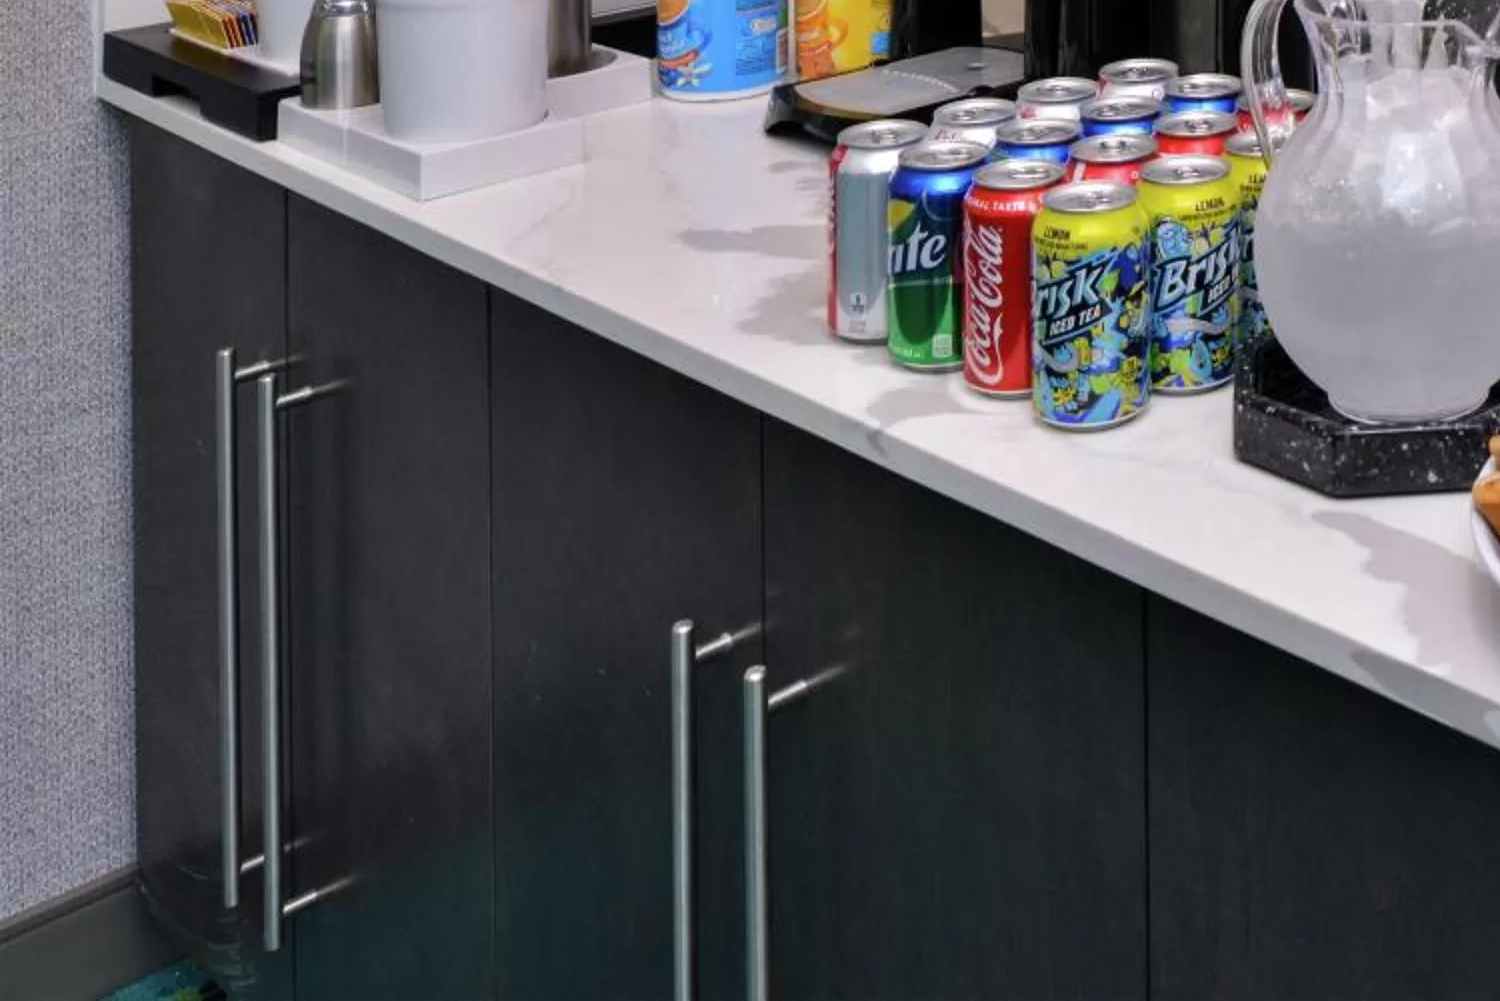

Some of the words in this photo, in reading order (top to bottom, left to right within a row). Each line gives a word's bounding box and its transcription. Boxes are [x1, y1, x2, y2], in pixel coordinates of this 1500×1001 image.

[1034, 263, 1104, 319] risk
[1049, 316, 1076, 337] ICED
[1078, 303, 1102, 326] TEA
